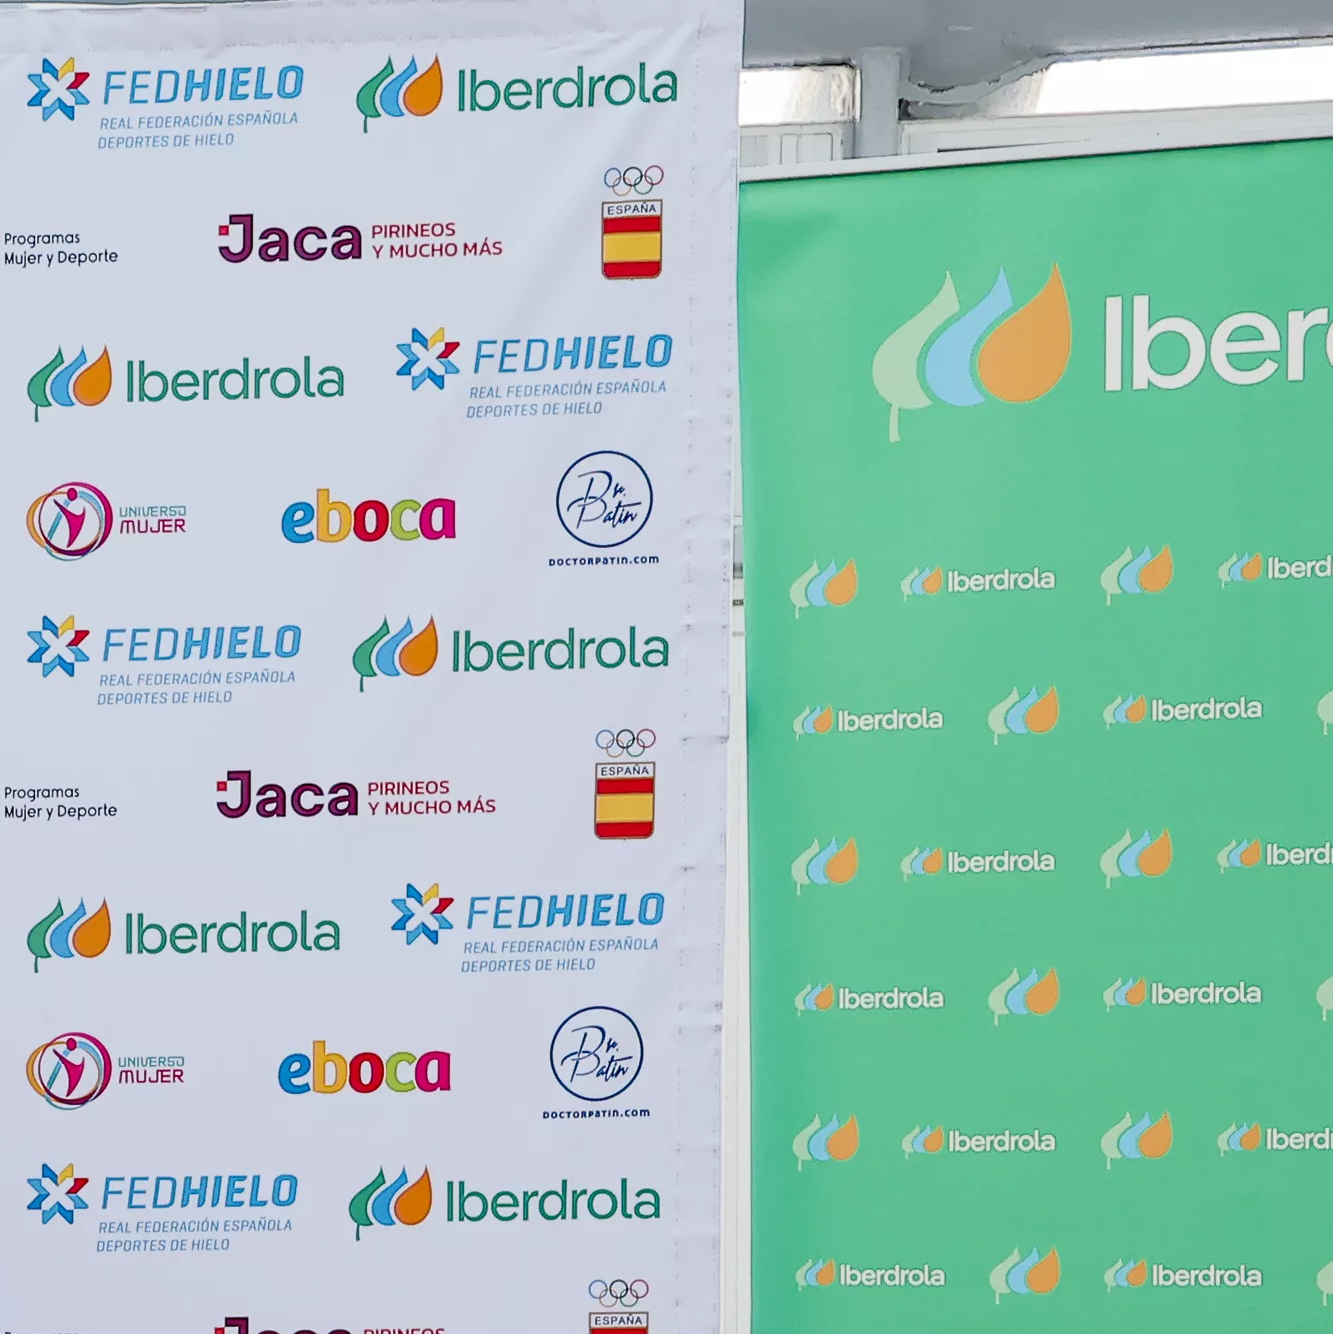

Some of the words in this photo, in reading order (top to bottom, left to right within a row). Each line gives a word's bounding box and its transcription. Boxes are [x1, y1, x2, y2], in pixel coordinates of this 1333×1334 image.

[459, 62, 677, 111] Iberdrola
[607, 202, 657, 216] ESPAÑA
[474, 334, 672, 373] FEDHIELO
[282, 488, 456, 543] eboca
[948, 568, 1056, 592] Iberdrola
[839, 708, 944, 731] Iberdrola
[1151, 697, 1263, 721] Iberdrola
[1152, 982, 1262, 1004] Iberdrola
[102, 1174, 298, 1209] FEDHIELO
[447, 1178, 660, 1222] Iberdrola
